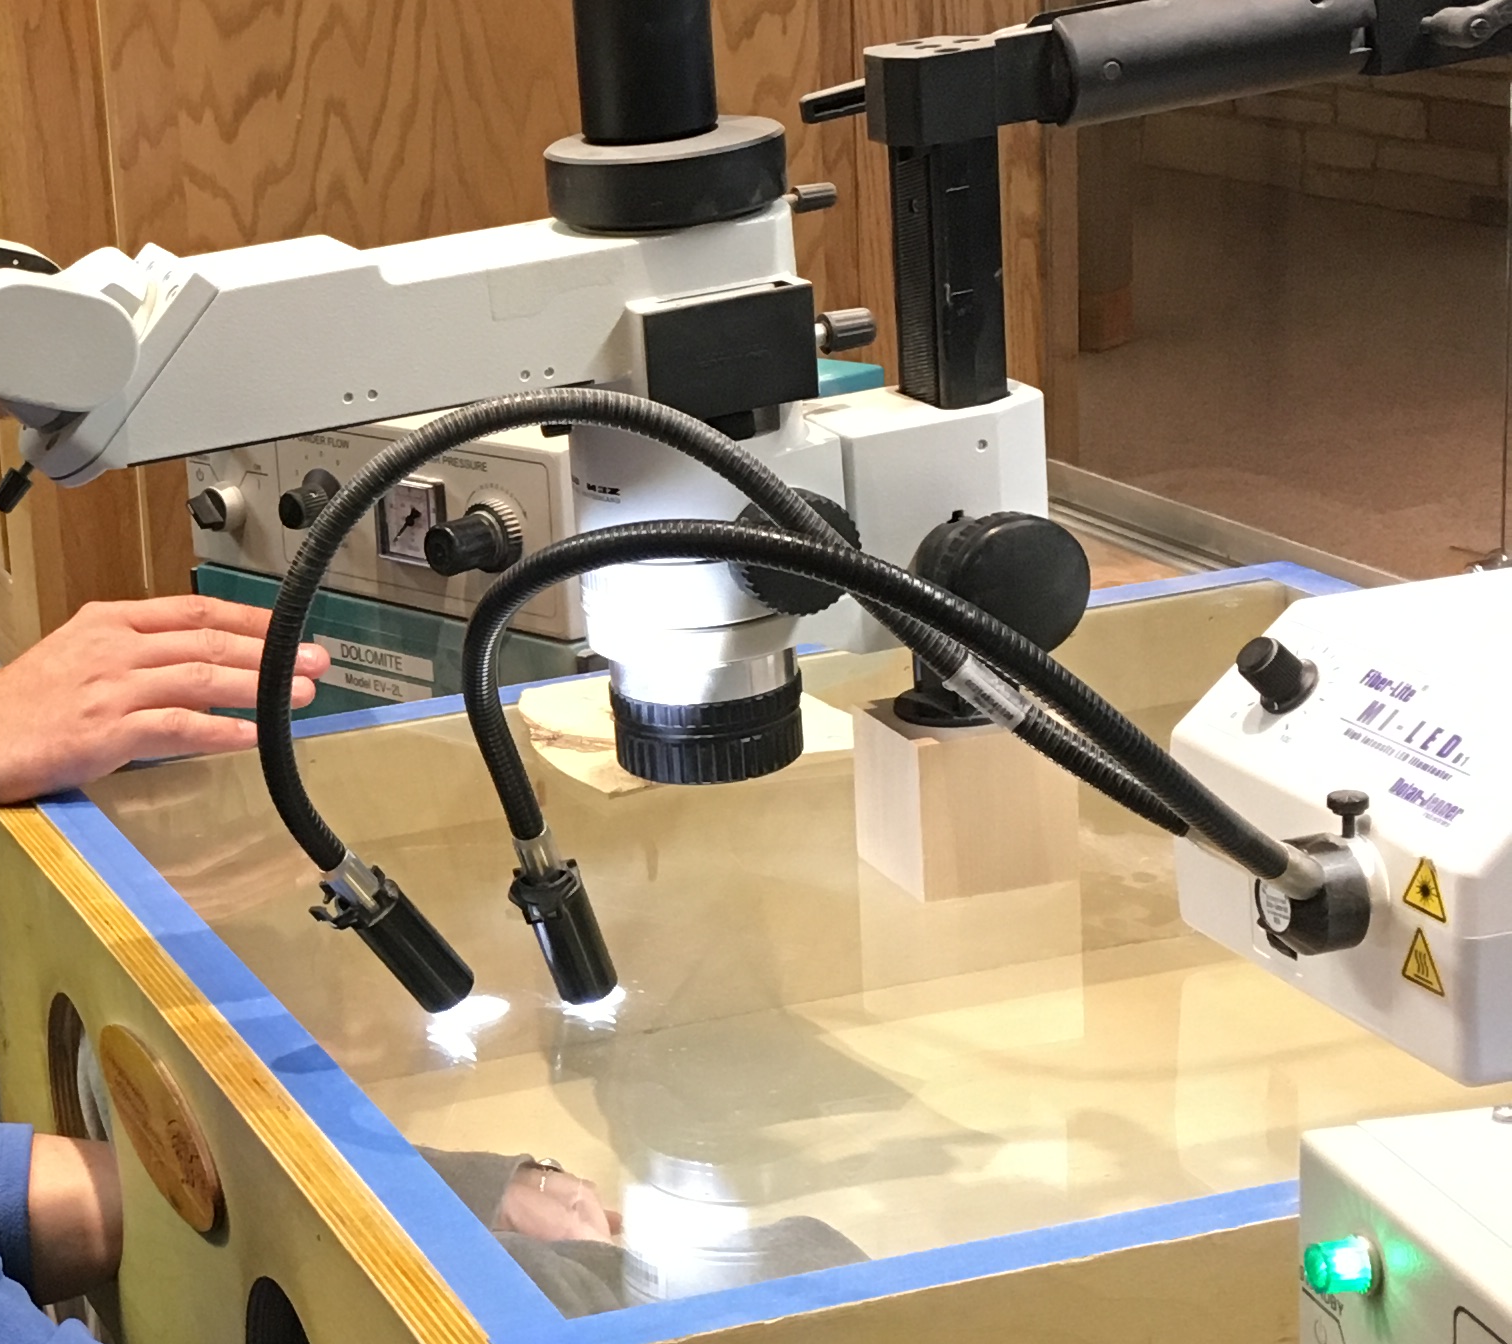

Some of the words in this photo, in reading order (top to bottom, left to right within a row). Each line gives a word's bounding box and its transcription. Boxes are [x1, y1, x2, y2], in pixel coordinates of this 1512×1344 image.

[443, 456, 487, 472] PRESSURE
[341, 644, 403, 671] DOLOMITE
[345, 673, 371, 688] Model
[374, 679, 403, 697] EV-2L
[1359, 668, 1417, 702] Fiber-Lite
[1343, 727, 1362, 741] High
[1361, 736, 1395, 756] Intensity
[1408, 756, 1453, 781] Illuminator
[1388, 777, 1465, 822] Dolan-Jenner
